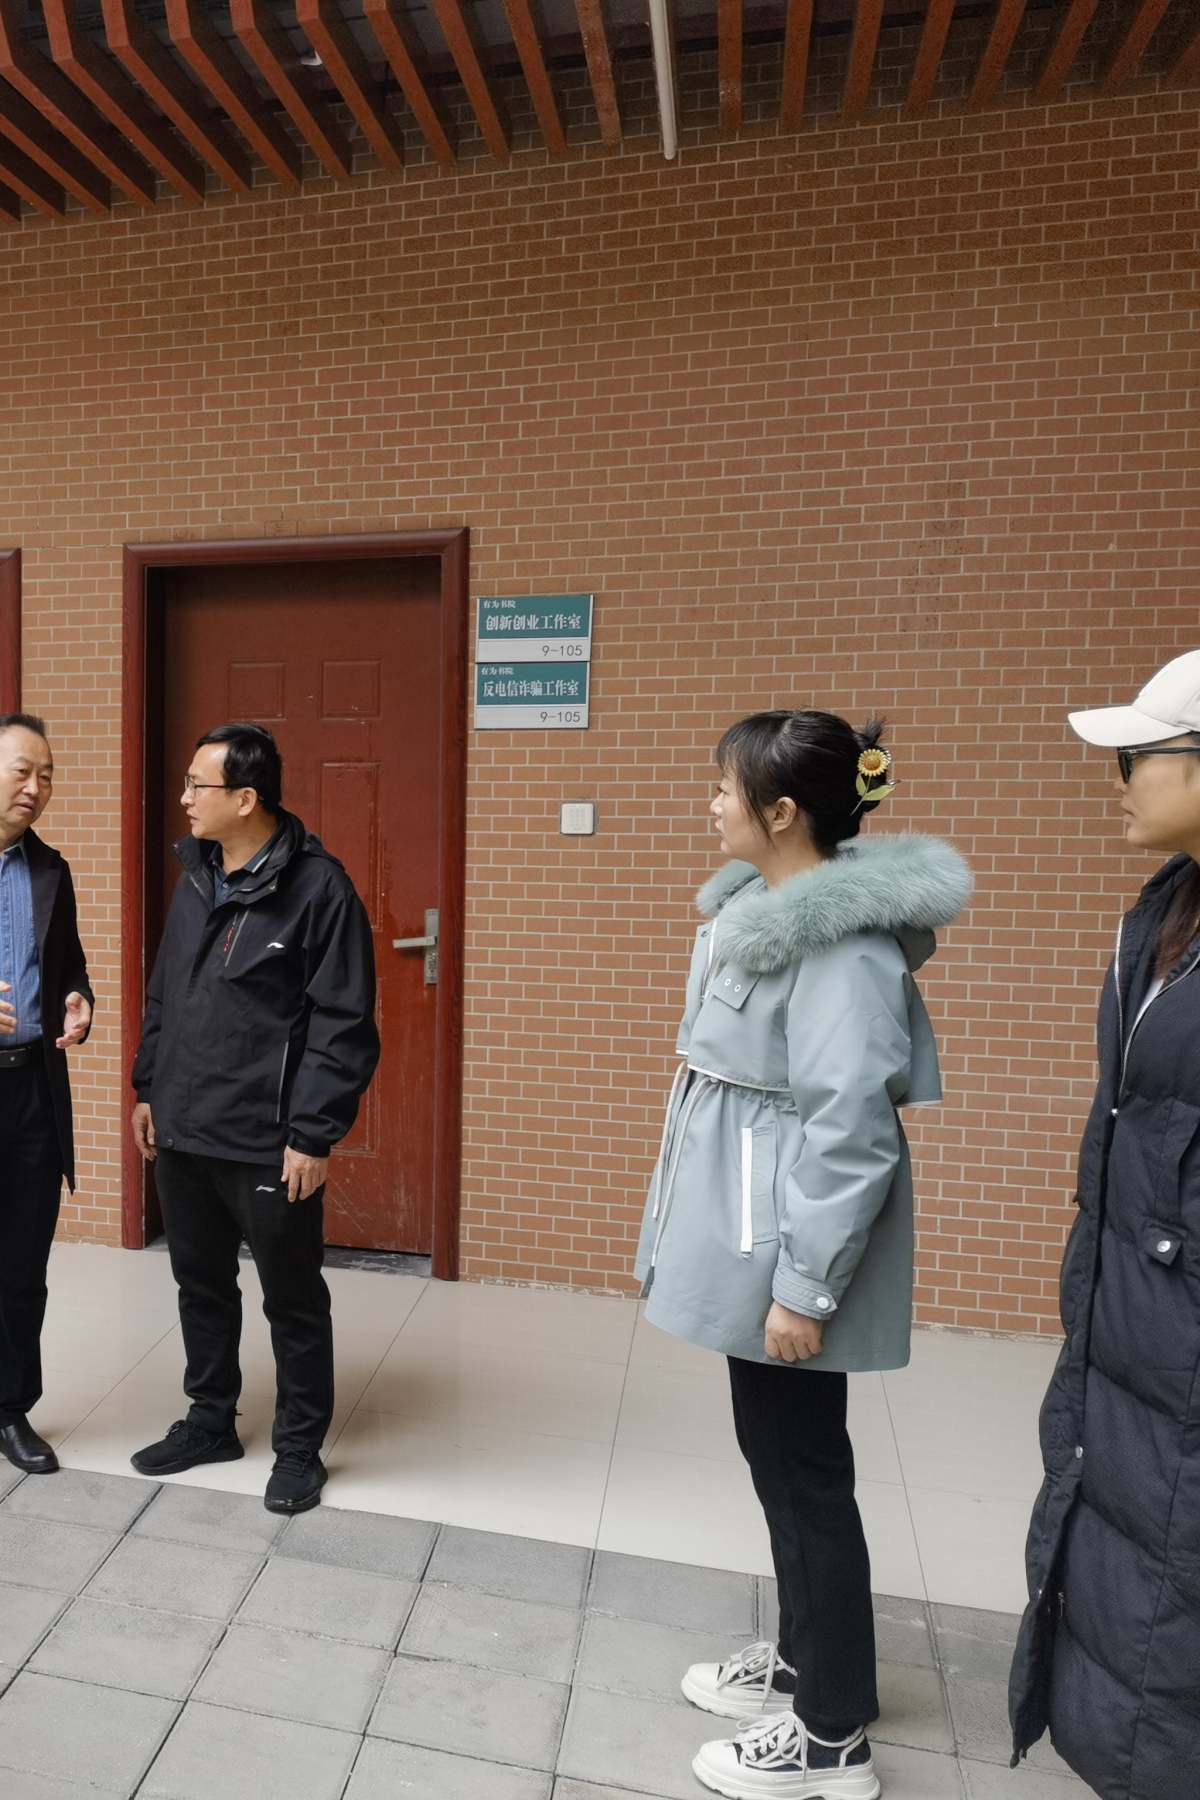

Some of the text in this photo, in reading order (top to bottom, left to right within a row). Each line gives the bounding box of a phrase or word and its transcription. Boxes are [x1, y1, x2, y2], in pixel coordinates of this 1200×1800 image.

[486, 613, 581, 631] 创新创业工作室
[541, 644, 583, 657] 9-105
[483, 680, 579, 697] 反电信诈骗工作室
[540, 711, 580, 723] 9-105
